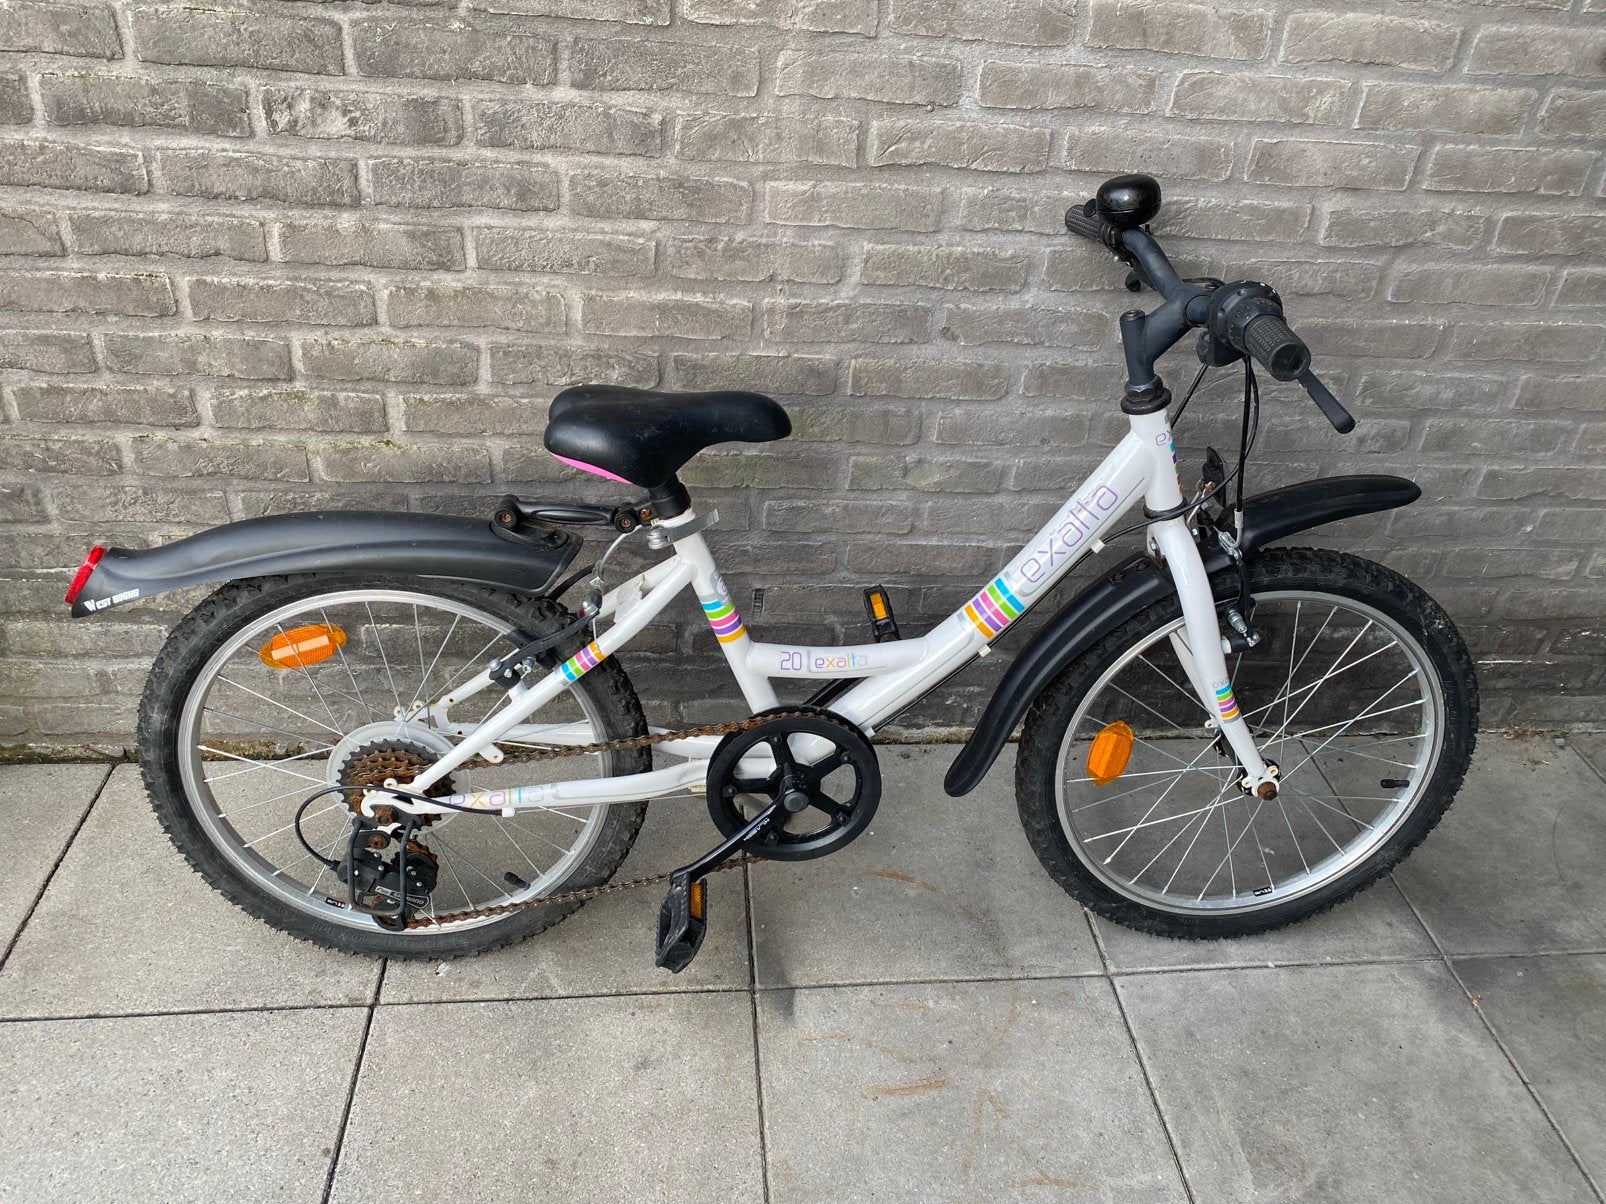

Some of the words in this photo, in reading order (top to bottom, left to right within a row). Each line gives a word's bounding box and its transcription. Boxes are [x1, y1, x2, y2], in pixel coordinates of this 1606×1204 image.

[1020, 485, 1118, 583] exalta
[780, 651, 802, 670] 20
[815, 653, 868, 669] exalta
